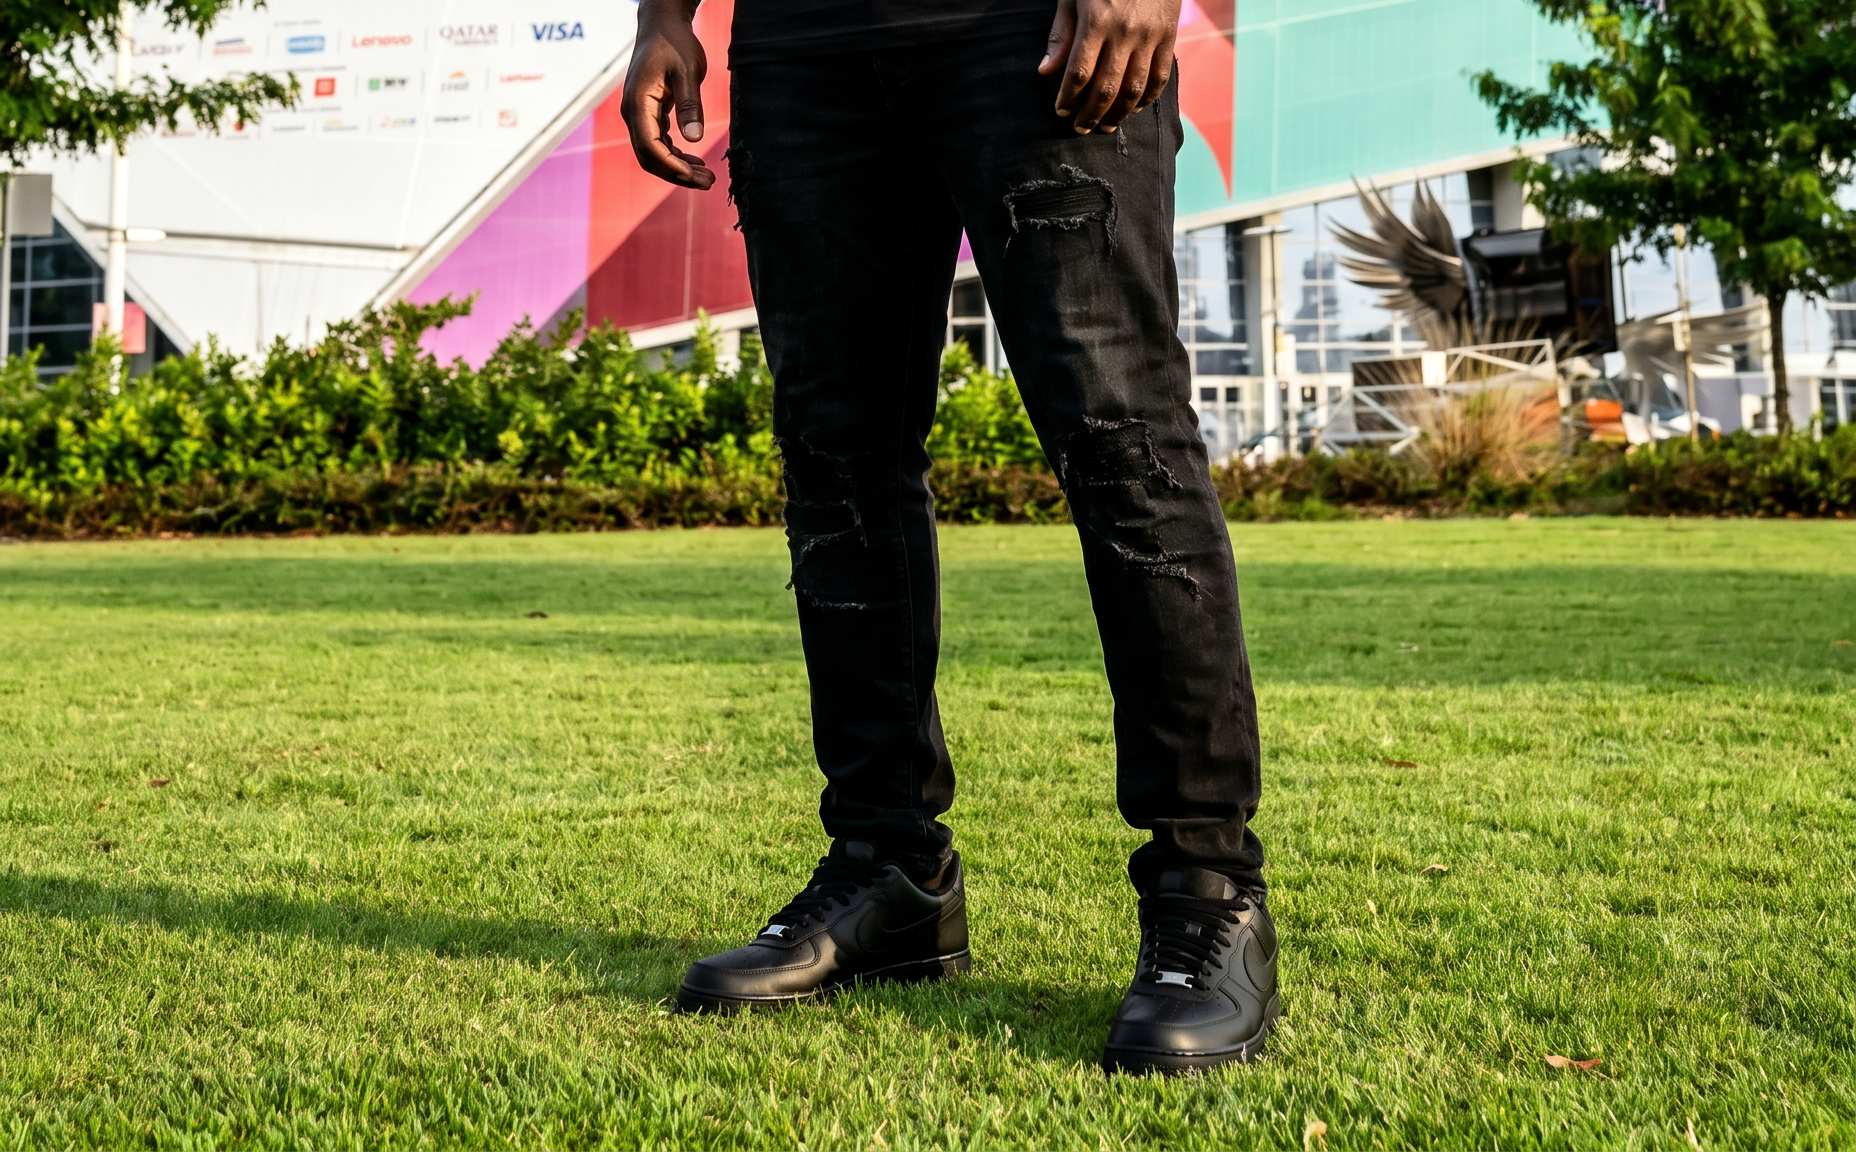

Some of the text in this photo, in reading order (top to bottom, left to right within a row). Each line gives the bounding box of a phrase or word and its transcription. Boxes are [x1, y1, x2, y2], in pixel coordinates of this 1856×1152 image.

[439, 23, 499, 41] QATAR
[531, 22, 584, 41] VISA
[352, 34, 413, 48] Lenovo
